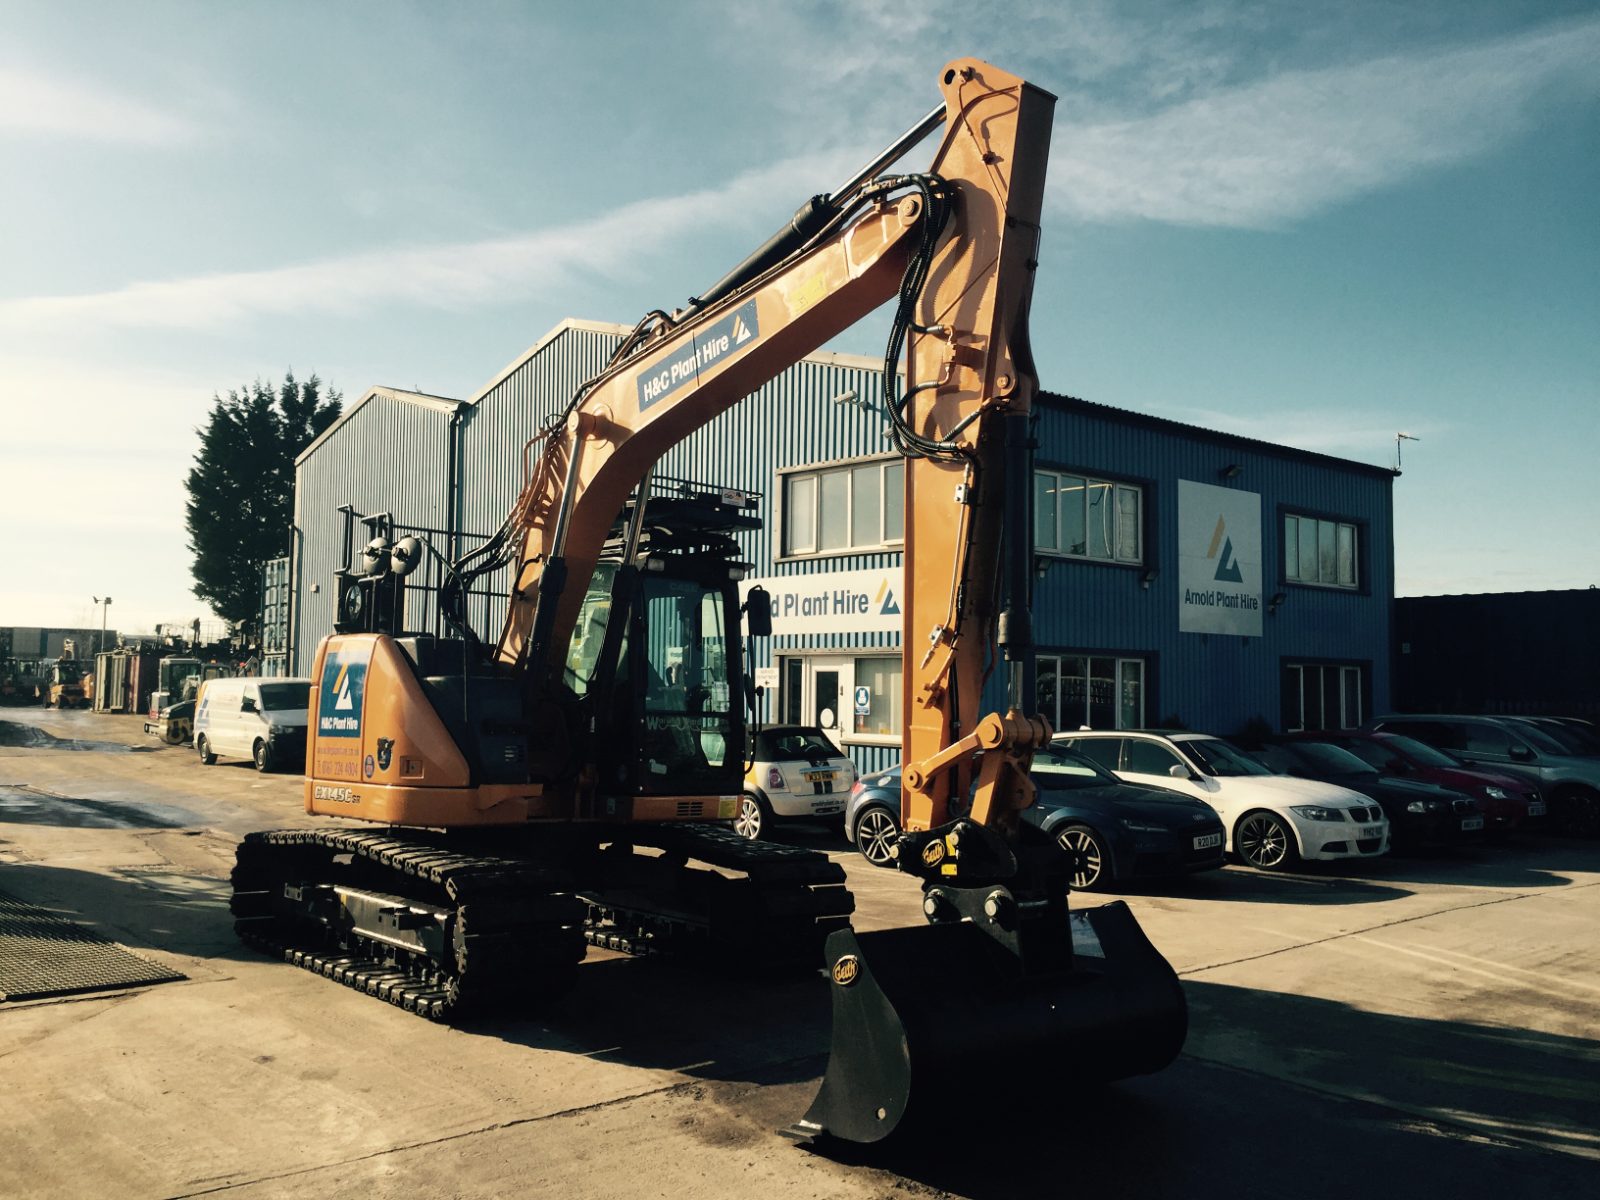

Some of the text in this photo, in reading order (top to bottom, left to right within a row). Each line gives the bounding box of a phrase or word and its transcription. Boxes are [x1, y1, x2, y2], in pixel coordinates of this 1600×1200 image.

[643, 334, 729, 402] H&C Plant Hire
[784, 591, 829, 617] Plant
[833, 590, 869, 615] Hire
[1185, 588, 1258, 610] Arnold Plant Hire
[321, 717, 358, 730] H&C Plant Hire
